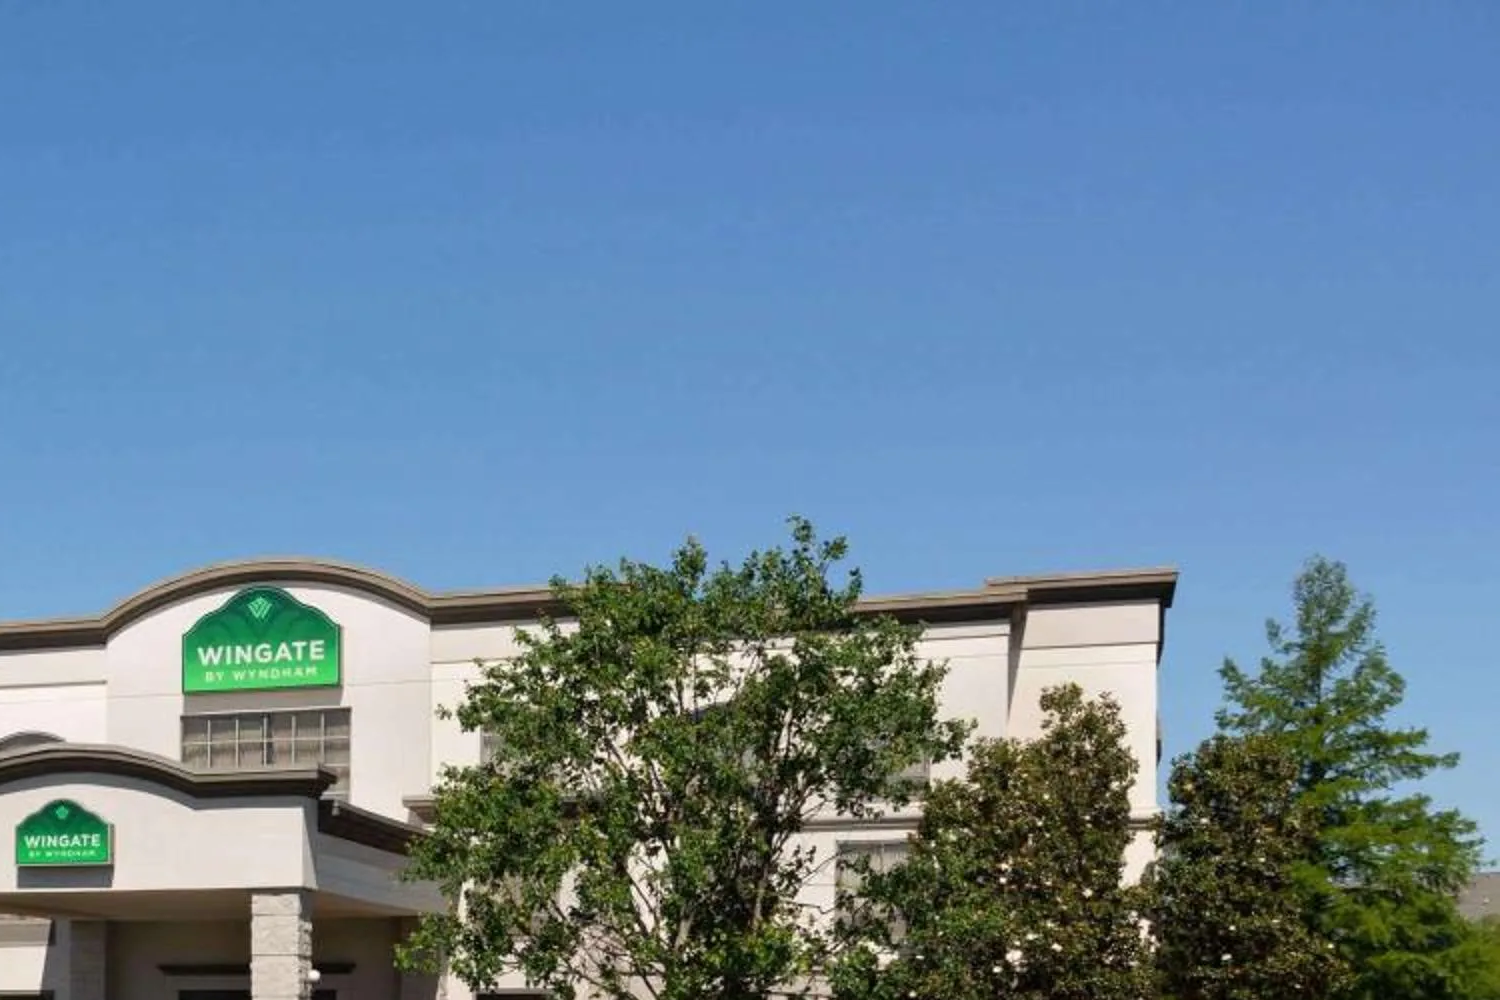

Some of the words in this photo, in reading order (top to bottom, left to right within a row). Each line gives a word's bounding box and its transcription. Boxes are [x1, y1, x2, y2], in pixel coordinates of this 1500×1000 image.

[197, 640, 325, 666] WINGATE
[205, 671, 225, 682] BY
[232, 666, 318, 681] WYNDHAM
[23, 833, 101, 849] WINGATE
